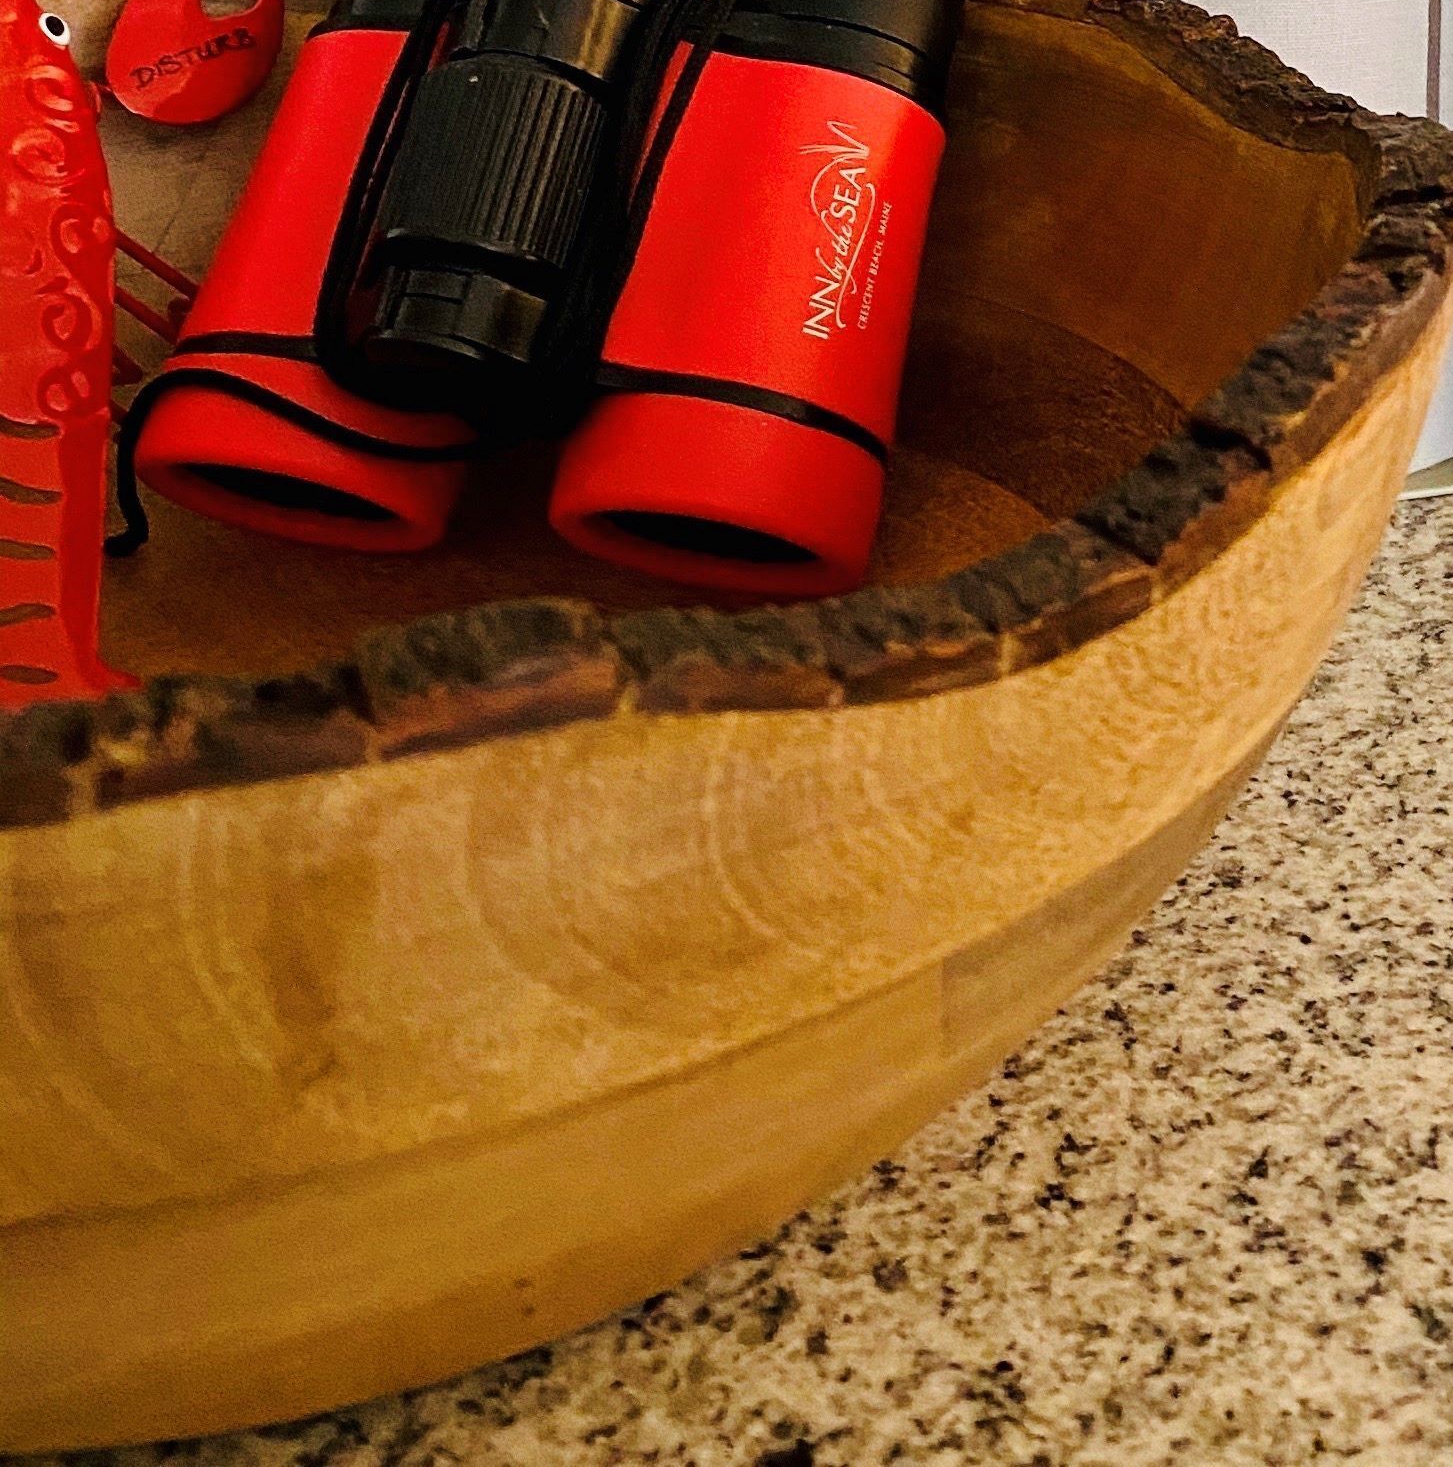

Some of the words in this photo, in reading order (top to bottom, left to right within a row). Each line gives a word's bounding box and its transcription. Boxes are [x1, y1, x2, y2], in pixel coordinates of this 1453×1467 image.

[130, 27, 257, 91] DISTURB
[829, 167, 867, 224] SEA
[820, 210, 853, 257] the
[815, 246, 858, 295] by
[857, 277, 877, 330] CRESCENT
[878, 201, 893, 236] MAINE
[801, 275, 843, 340] INN
